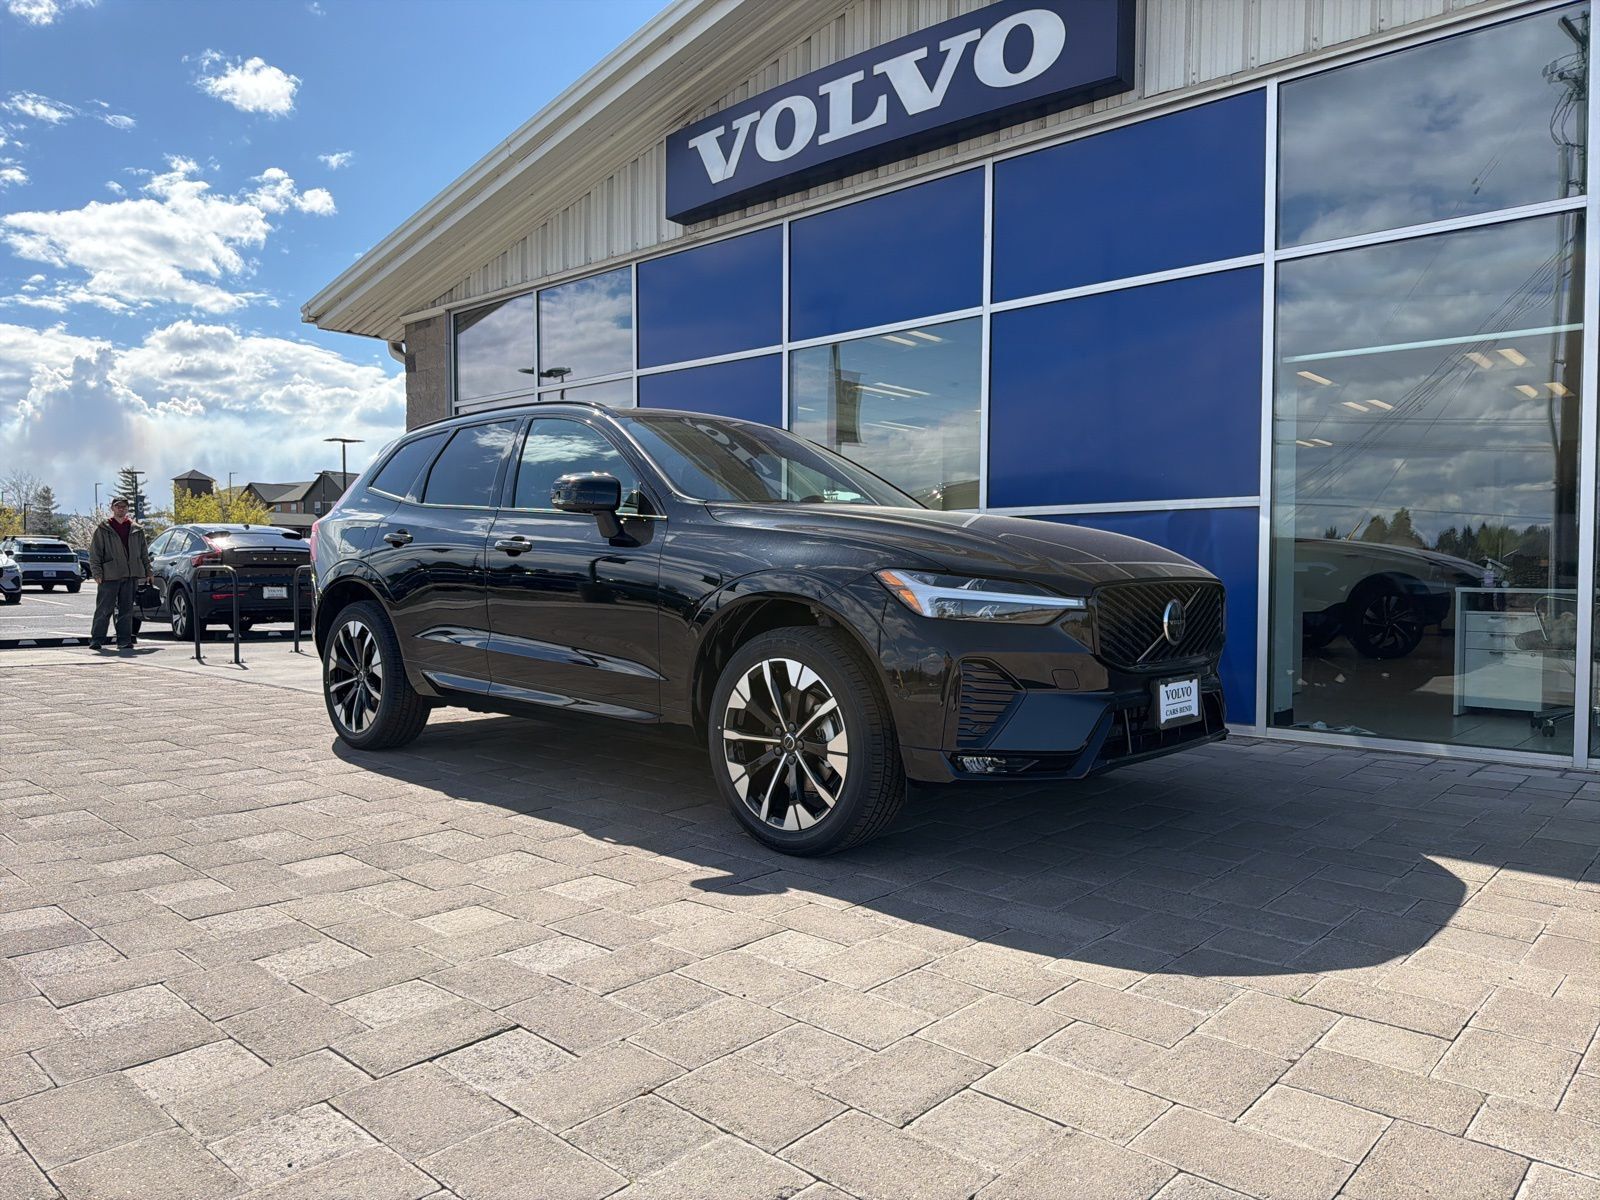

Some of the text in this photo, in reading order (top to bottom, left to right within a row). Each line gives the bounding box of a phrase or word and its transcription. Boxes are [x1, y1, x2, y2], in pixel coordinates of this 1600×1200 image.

[688, 9, 1066, 185] VOLVO
[1165, 686, 1192, 701] VOLVO
[1165, 705, 1192, 717] CARS BEND
